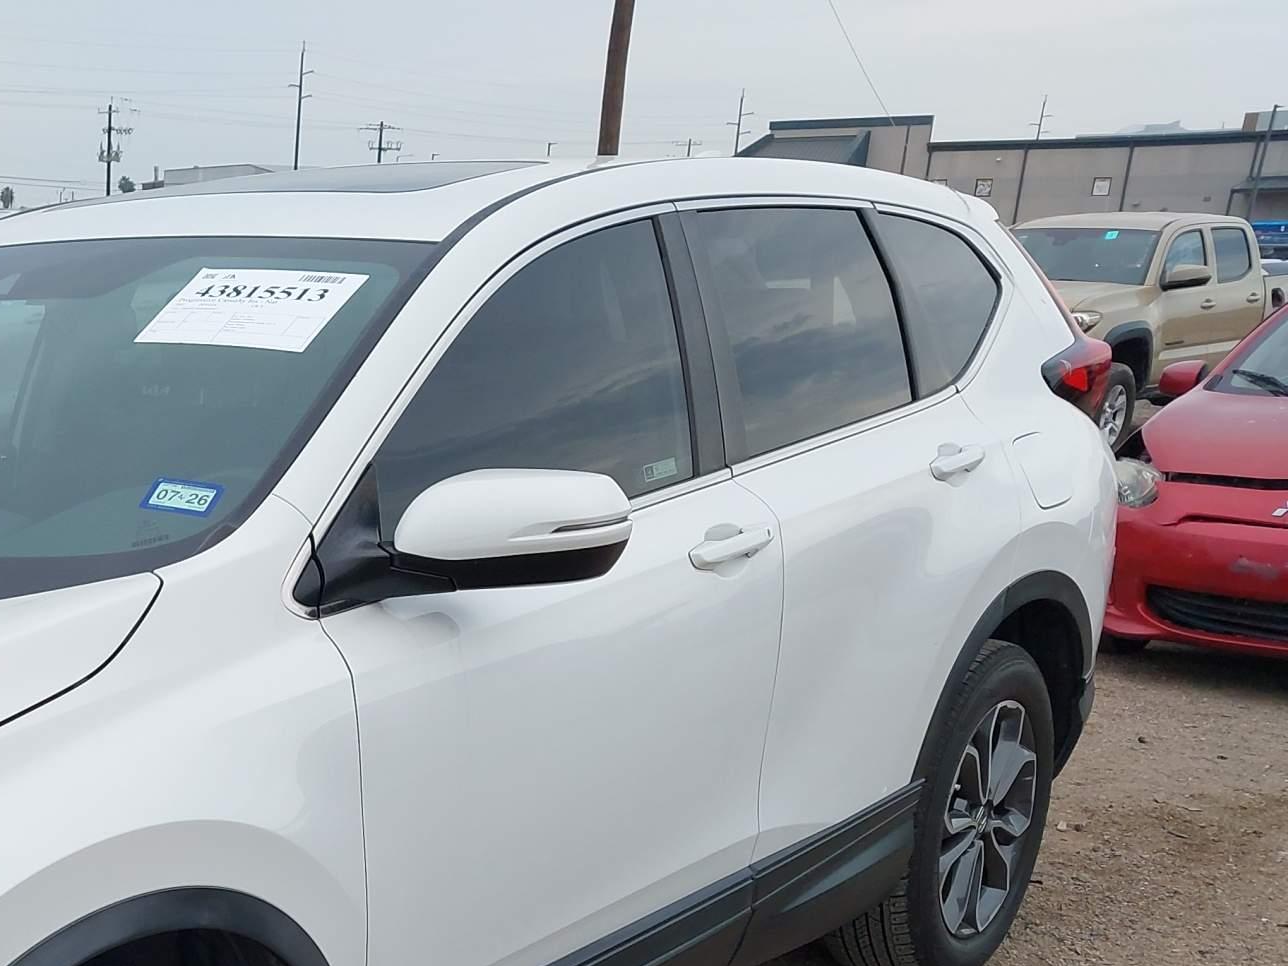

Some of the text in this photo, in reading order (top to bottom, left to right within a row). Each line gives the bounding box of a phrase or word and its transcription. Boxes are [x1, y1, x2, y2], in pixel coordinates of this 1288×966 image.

[195, 284, 330, 302] 43815513
[156, 489, 210, 506] 07 26
